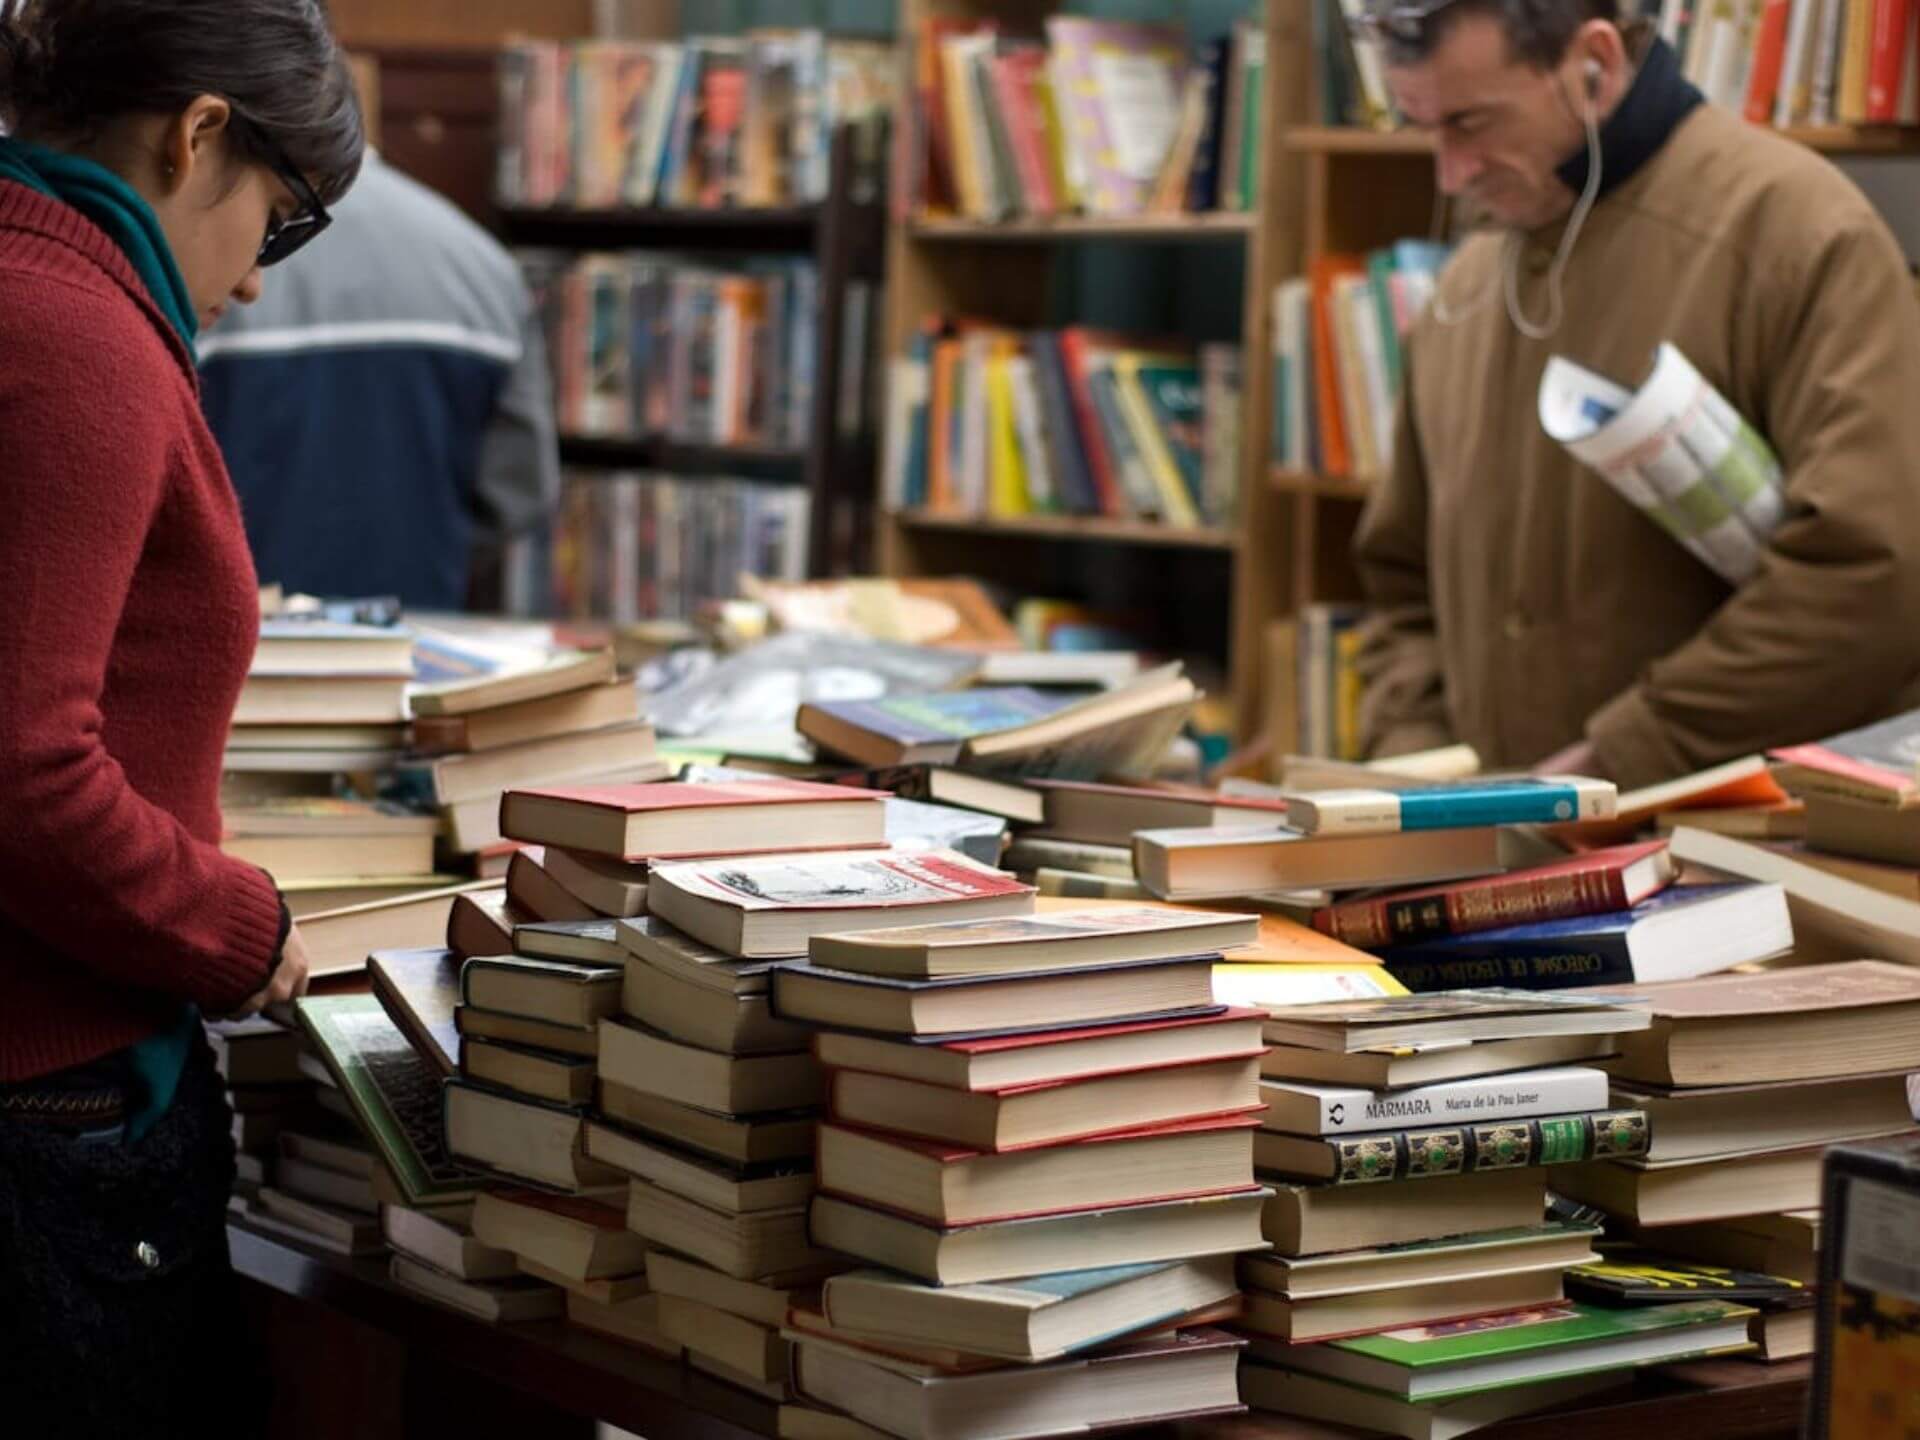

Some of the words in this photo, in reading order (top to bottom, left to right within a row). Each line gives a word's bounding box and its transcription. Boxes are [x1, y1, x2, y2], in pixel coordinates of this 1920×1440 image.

[1445, 1097, 1472, 1110] Maria
[1473, 1095, 1485, 1108] de
[1487, 1095, 1495, 1107] la
[1498, 1093, 1515, 1106] Pau
